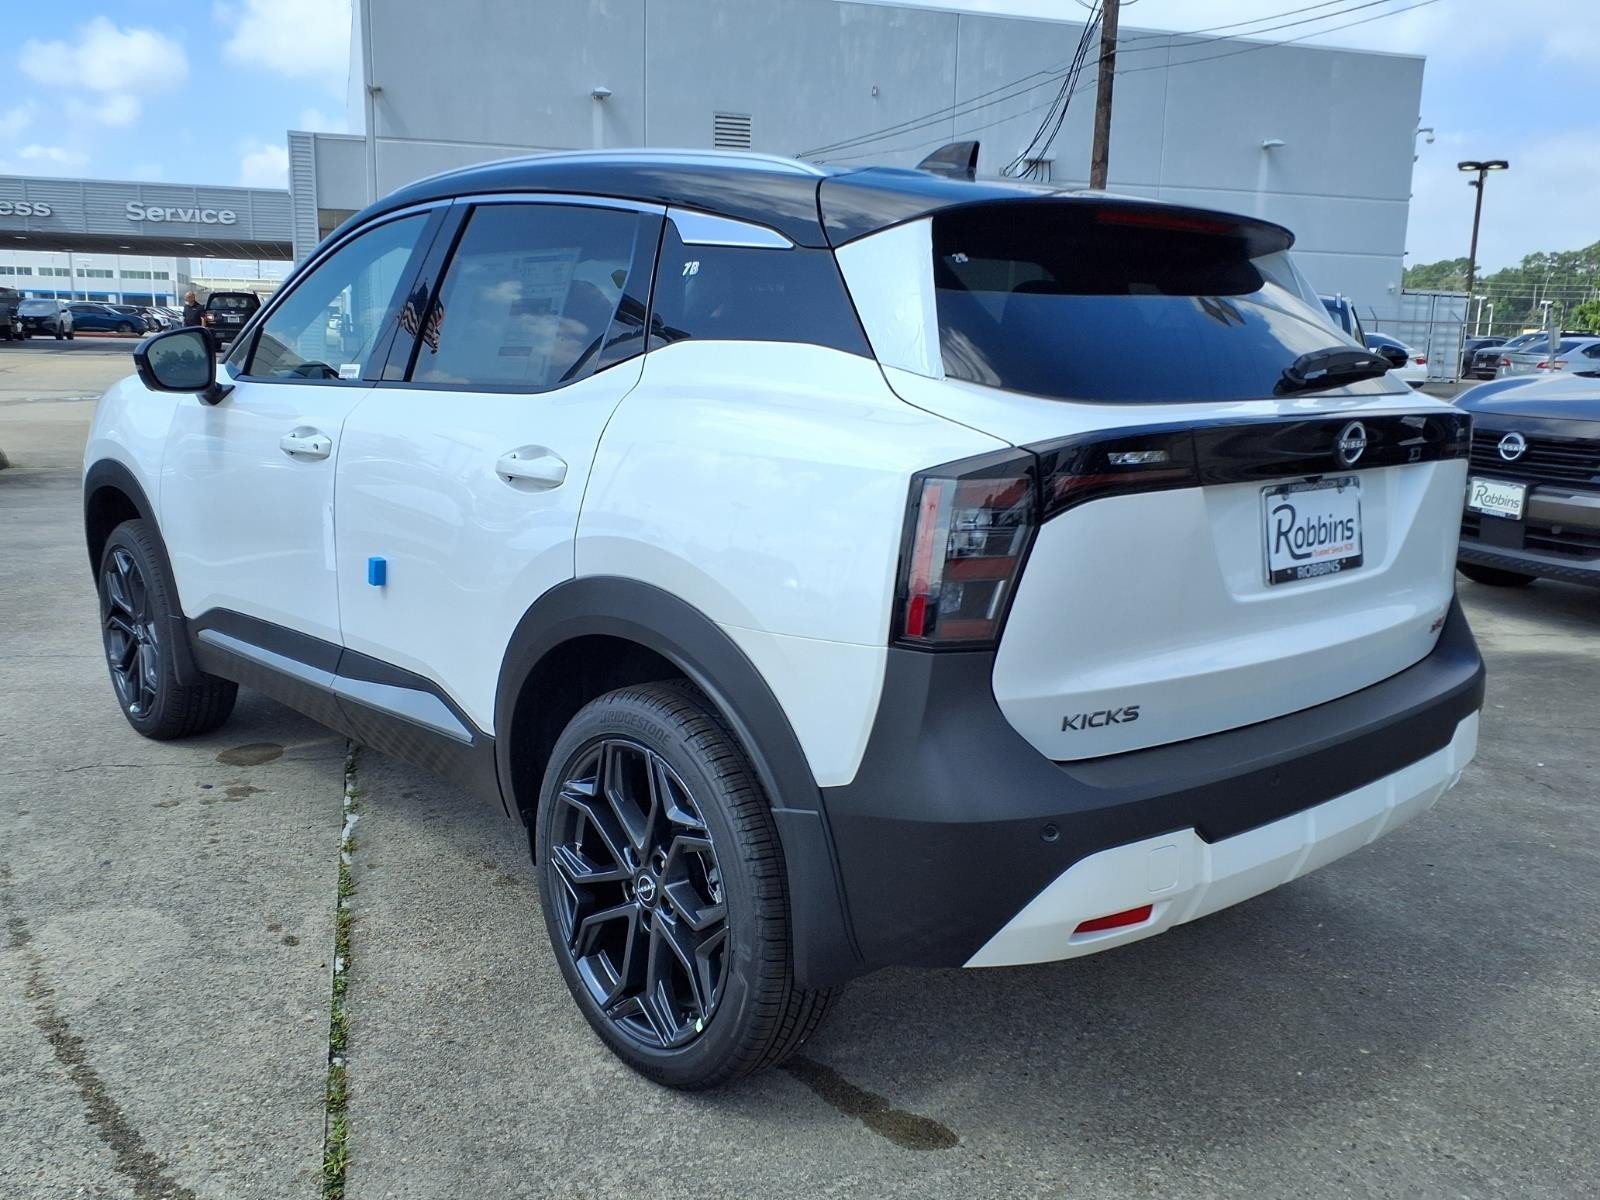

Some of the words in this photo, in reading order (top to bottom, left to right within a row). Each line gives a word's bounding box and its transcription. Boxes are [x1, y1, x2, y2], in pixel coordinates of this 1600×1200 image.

[126, 201, 236, 225] Service
[1340, 440, 1367, 449] NISSA
[1475, 484, 1520, 509] Robbins
[1272, 503, 1354, 560] Robbins
[1296, 560, 1341, 579] ROBBINS
[1061, 705, 1140, 732] KICKS
